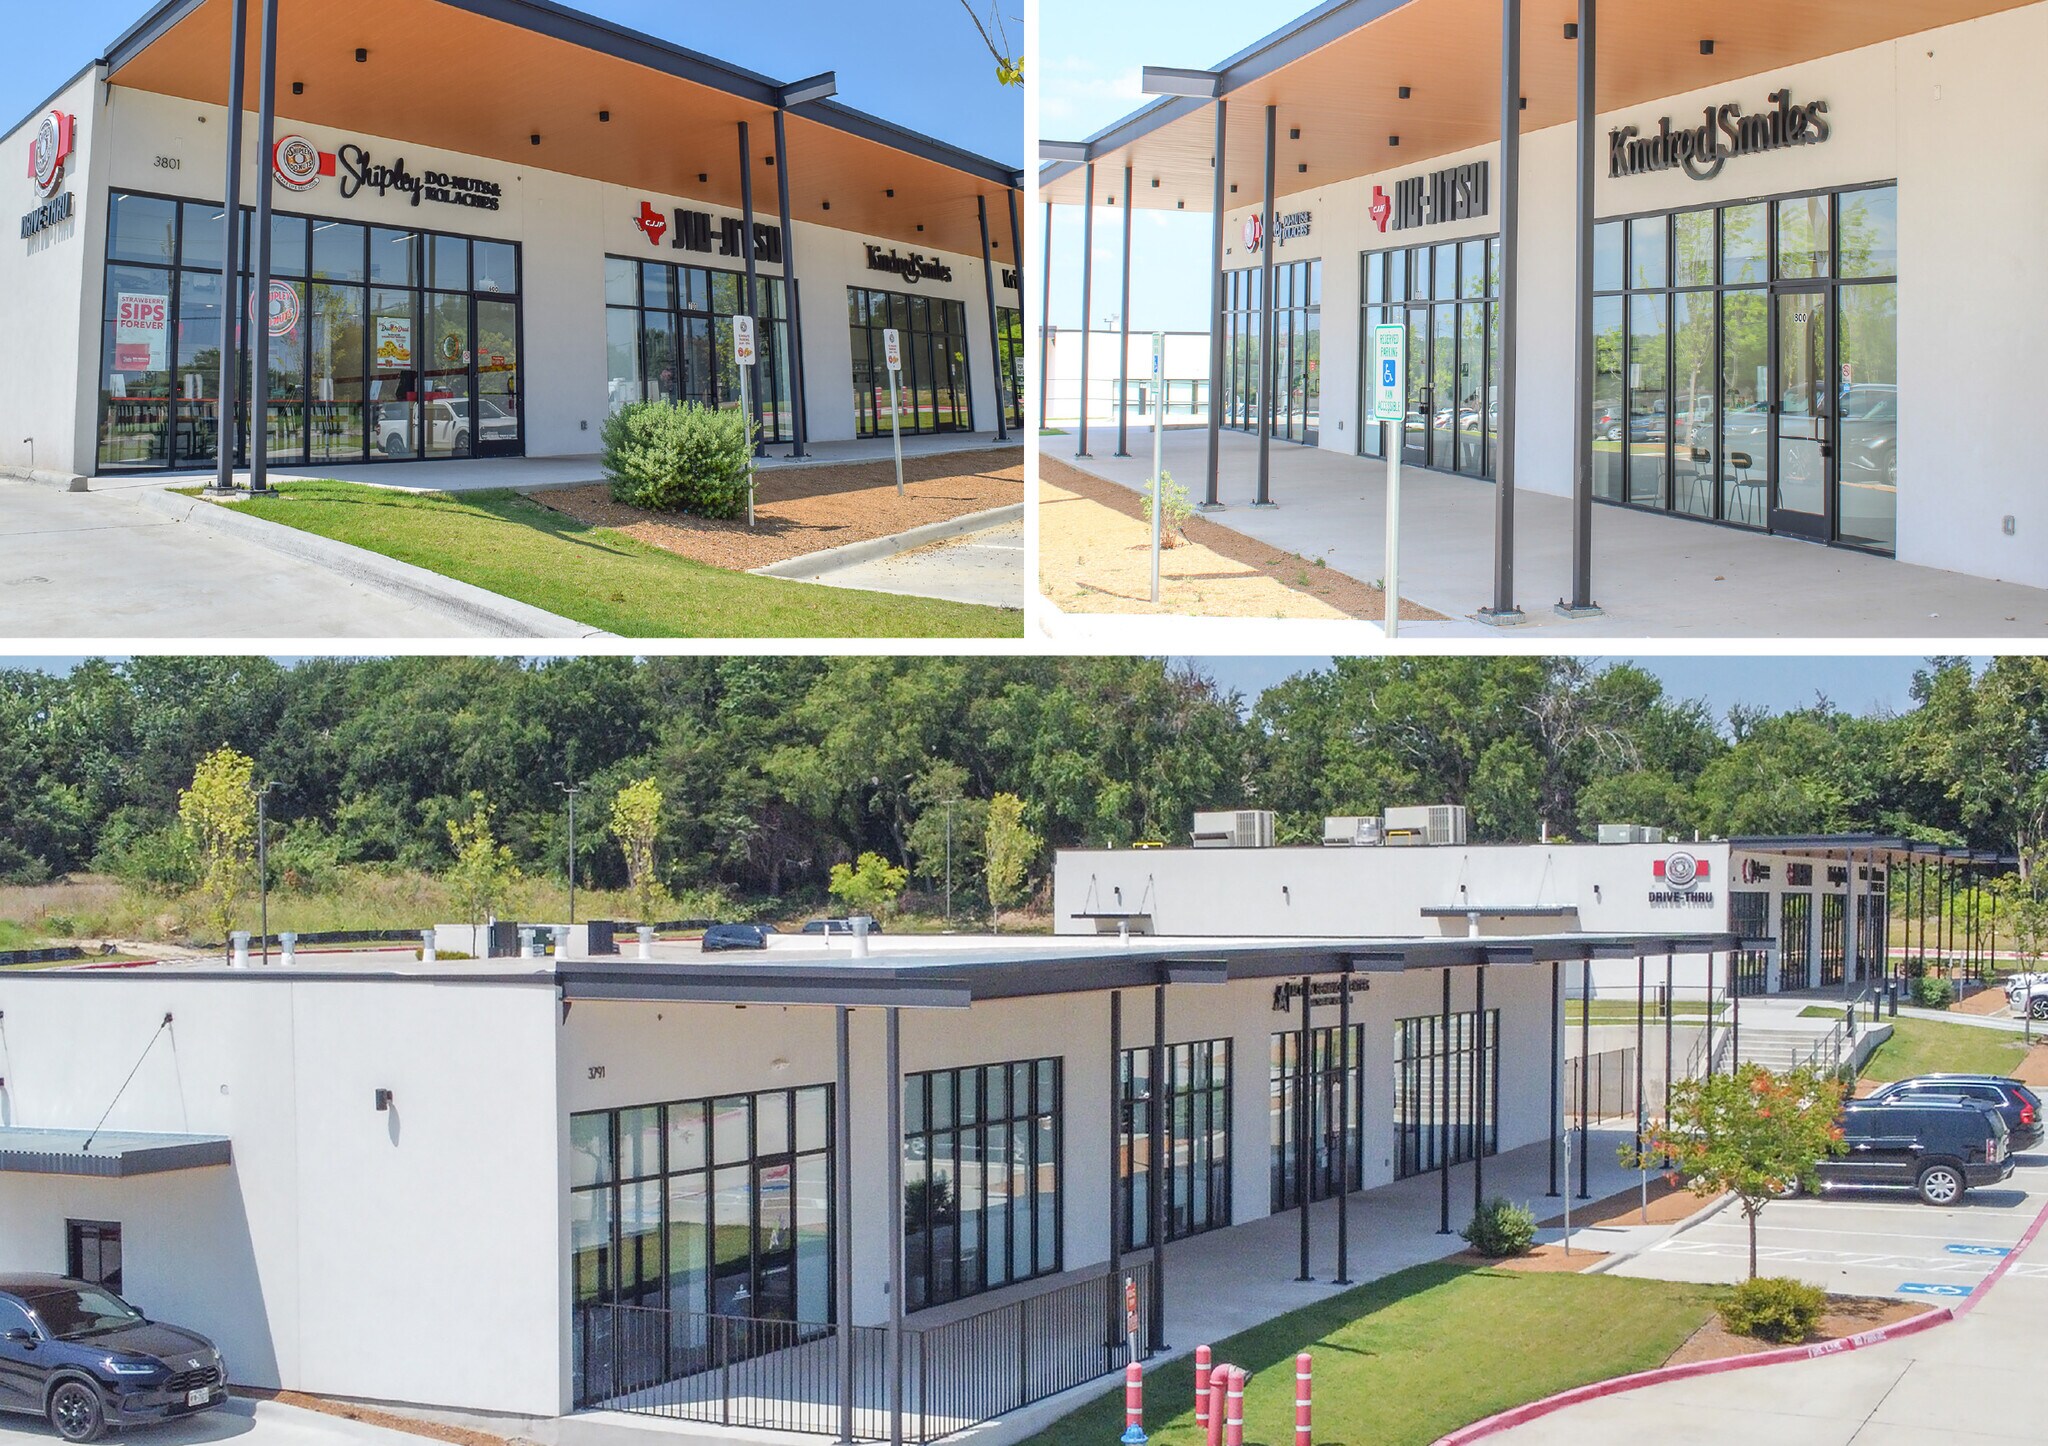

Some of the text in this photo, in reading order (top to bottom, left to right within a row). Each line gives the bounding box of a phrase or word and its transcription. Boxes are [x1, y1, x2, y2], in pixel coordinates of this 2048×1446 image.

[153, 155, 181, 170] 3801
[338, 144, 424, 206] Shipley
[424, 186, 500, 211] KOLACHES
[1391, 160, 1489, 231] JIU-JITSU
[20, 192, 72, 240] DRIVE-THRU
[121, 296, 165, 305] STRAWBERRY
[120, 302, 165, 321] SIPS
[120, 320, 164, 330] FOREVER
[1380, 346, 1398, 357] PARKING
[1378, 401, 1400, 412] ACCESSIBLE
[1648, 891, 1713, 903] DRIVE-THRU
[588, 1066, 606, 1080] 3791
